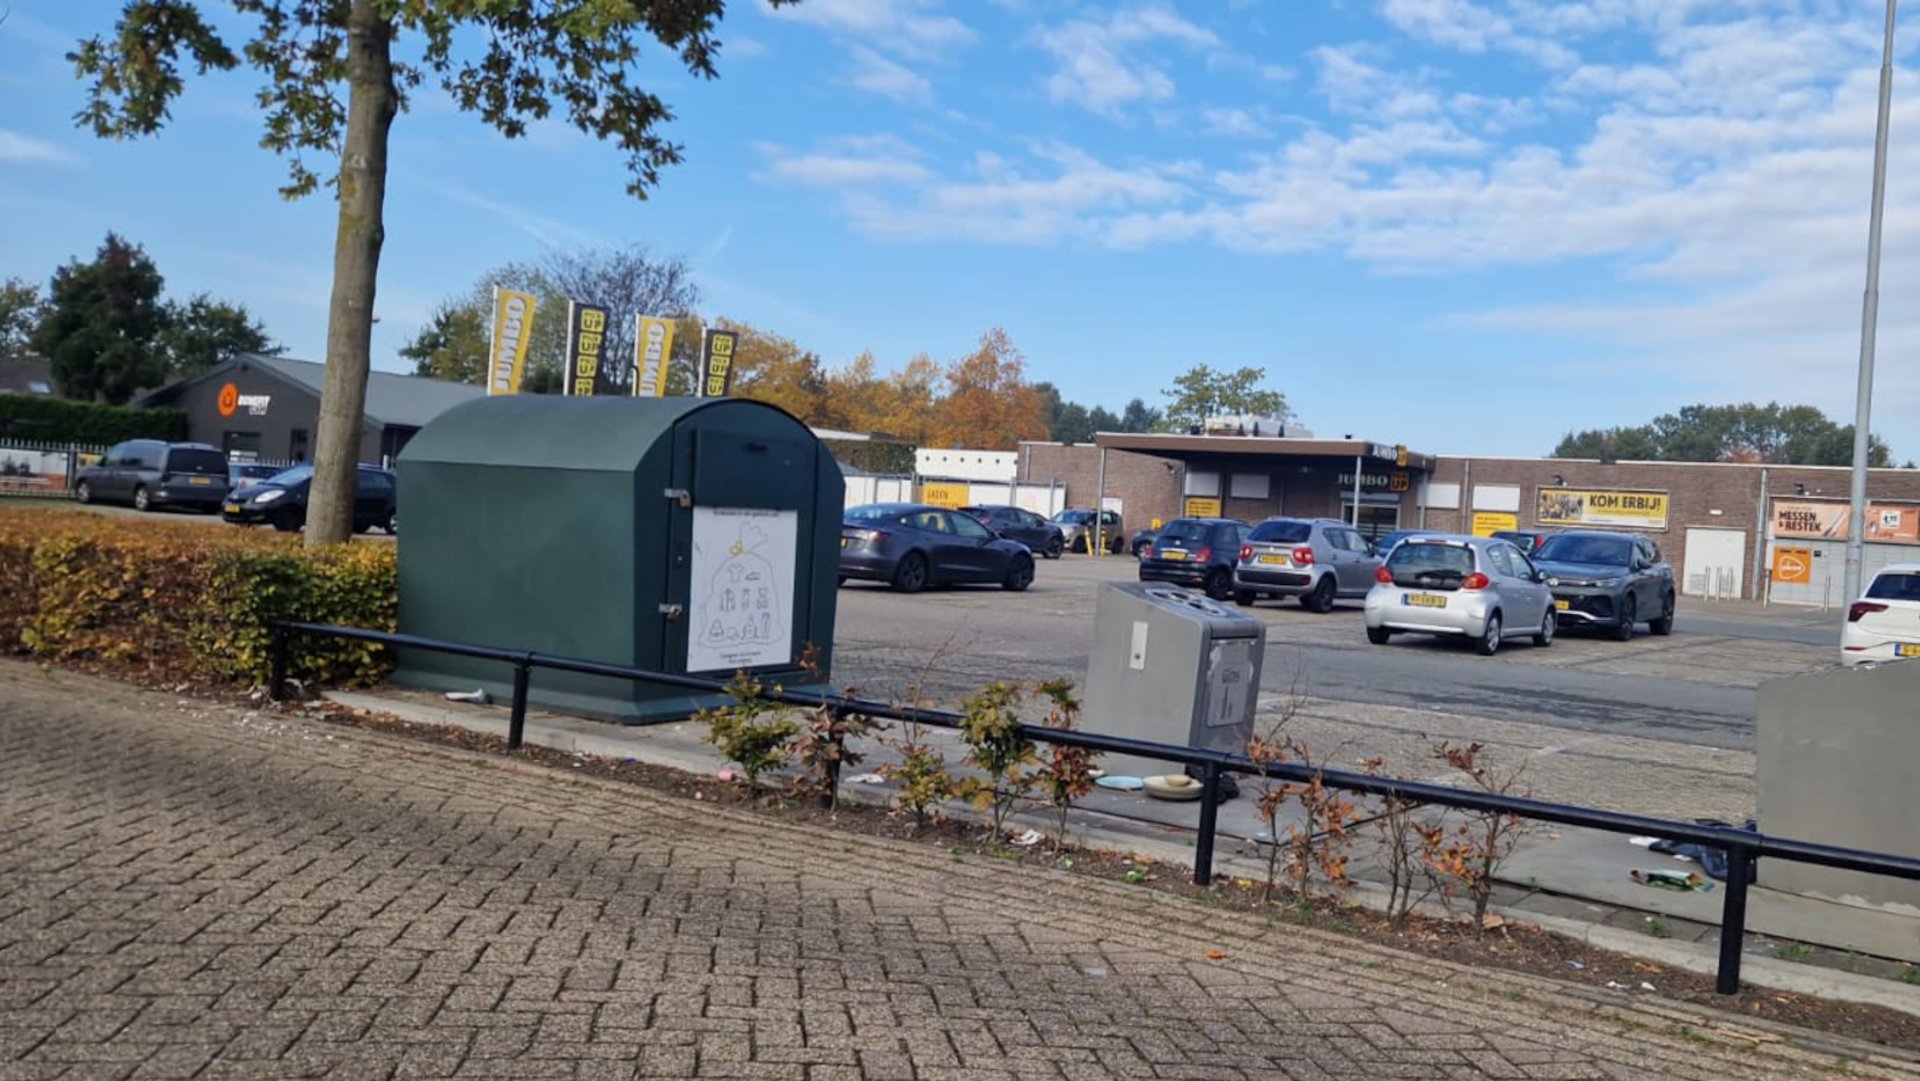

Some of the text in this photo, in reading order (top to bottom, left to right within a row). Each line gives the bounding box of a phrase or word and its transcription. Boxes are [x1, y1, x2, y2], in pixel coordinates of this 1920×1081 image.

[583, 319, 601, 329] UP
[495, 297, 525, 391] JUMBO
[581, 342, 597, 352] UP
[714, 343, 729, 352] UP
[641, 323, 664, 396] UMBO
[1589, 495, 1661, 510] KOM ERBIJ!
[1779, 511, 1817, 521] MESSEN
[1785, 521, 1822, 532] BESTEK
